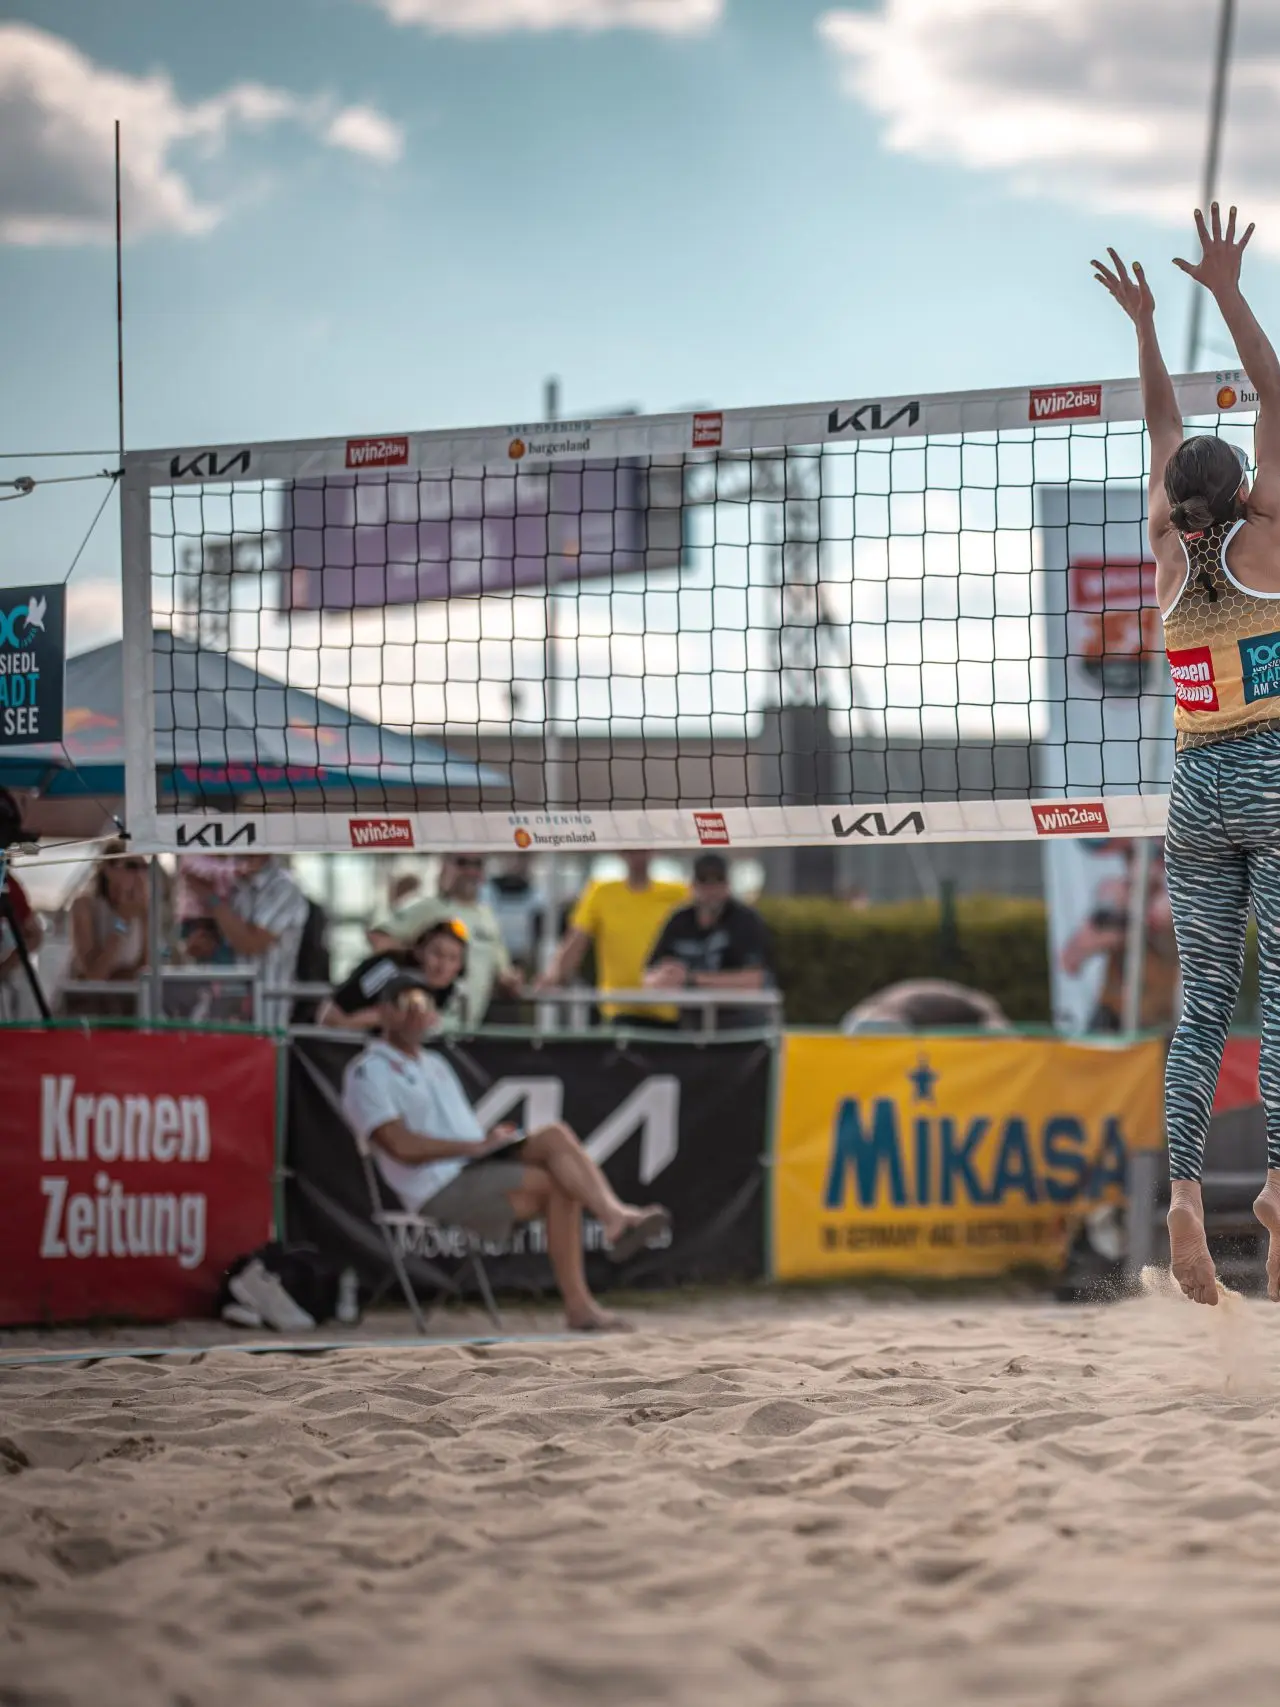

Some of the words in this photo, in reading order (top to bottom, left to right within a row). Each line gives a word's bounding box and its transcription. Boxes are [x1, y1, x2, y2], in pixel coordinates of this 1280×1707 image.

[1033, 389, 1098, 418] win2day
[827, 401, 920, 434] KIA
[170, 450, 251, 478] KIA
[349, 440, 406, 465] win2day
[1253, 682, 1270, 697] AM
[4, 706, 39, 736] SEE
[832, 811, 925, 838] KIA
[1037, 805, 1103, 831] win2day
[176, 822, 256, 848] KIA
[352, 822, 410, 845] win2day
[532, 830, 597, 847] burgenland
[40, 1074, 210, 1164] Kronen
[40, 1172, 208, 1270] Zeitung
